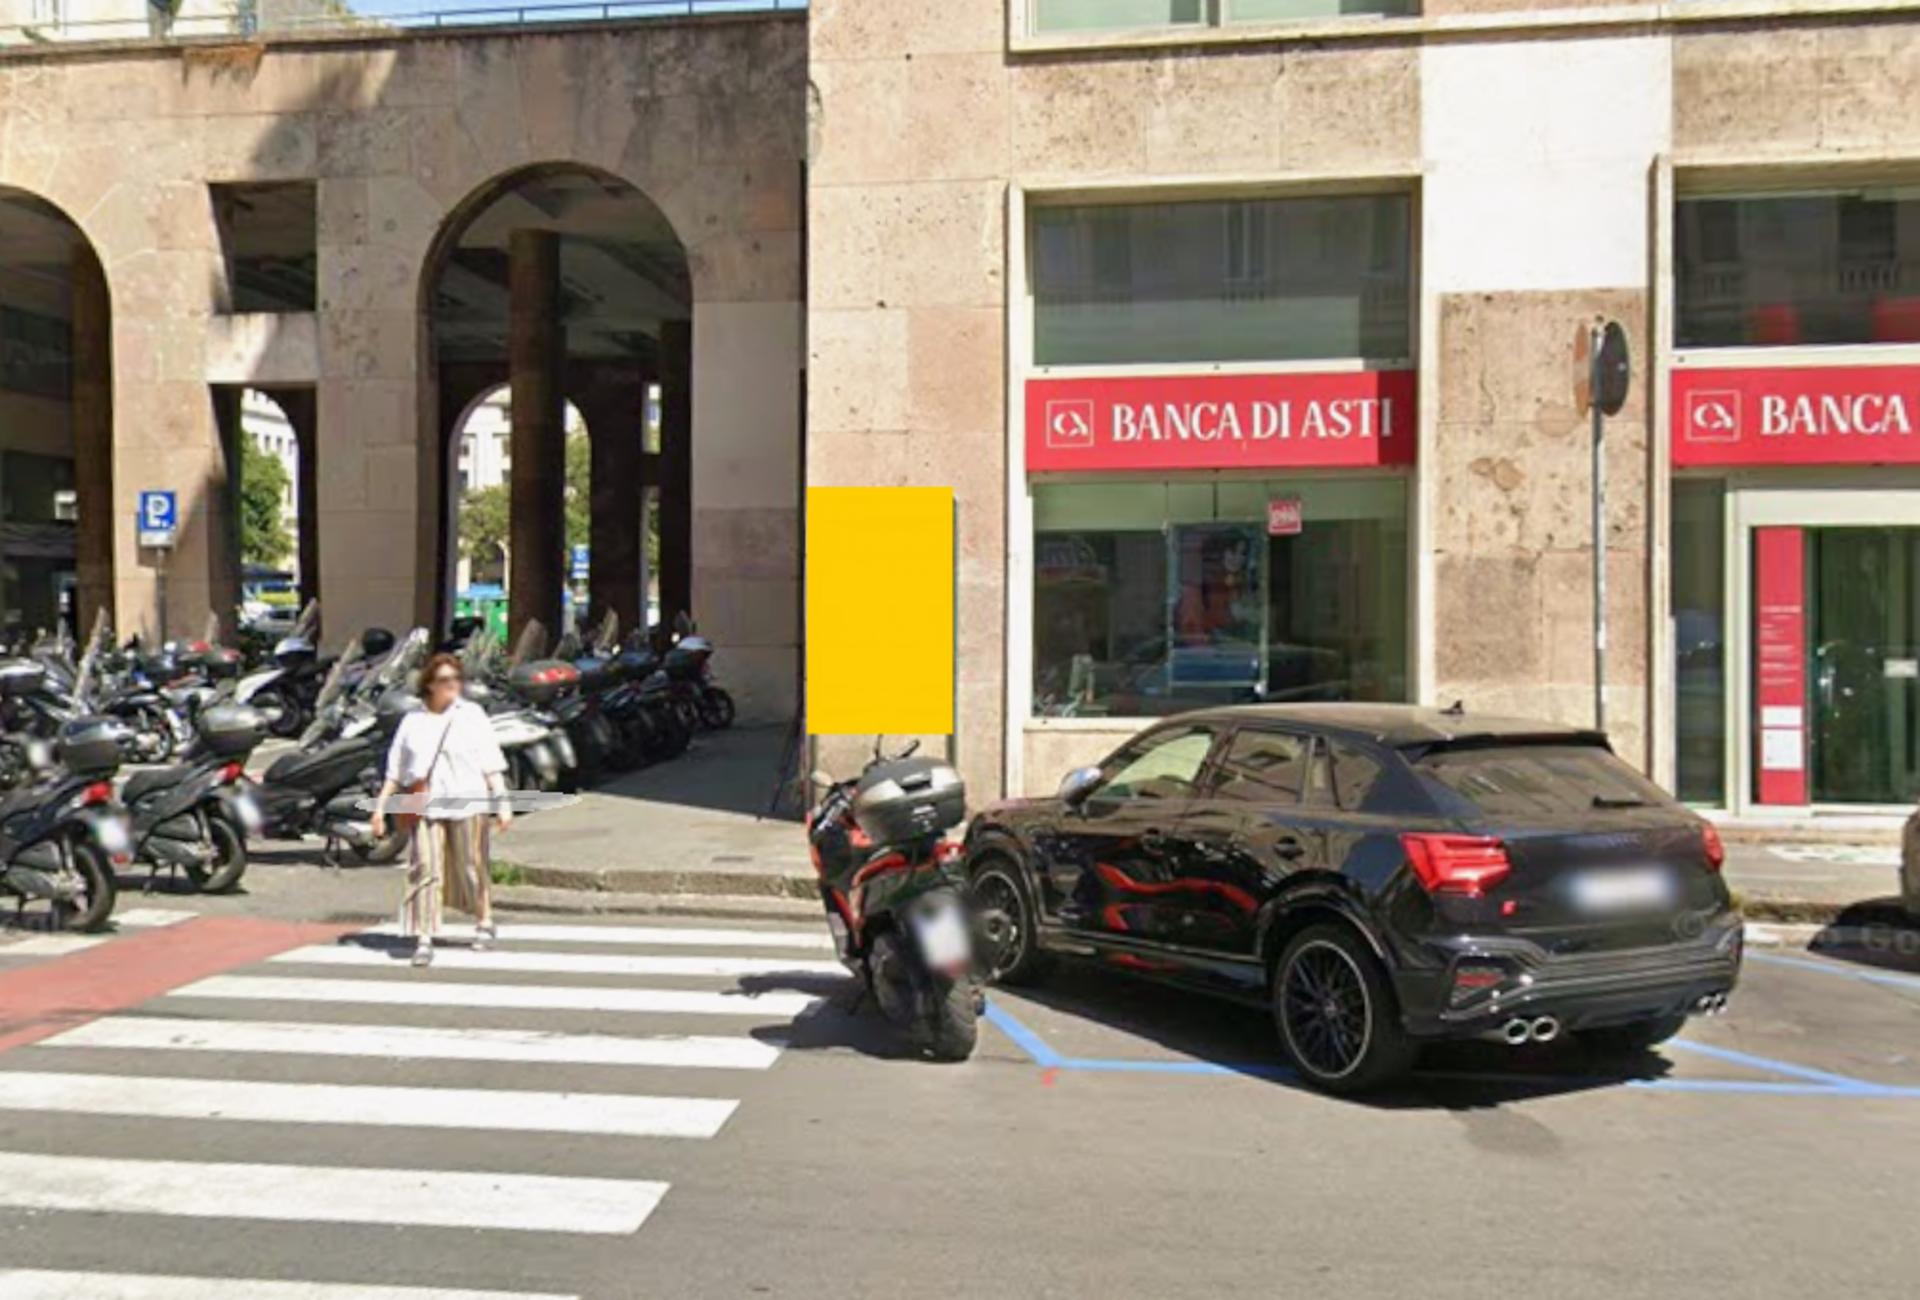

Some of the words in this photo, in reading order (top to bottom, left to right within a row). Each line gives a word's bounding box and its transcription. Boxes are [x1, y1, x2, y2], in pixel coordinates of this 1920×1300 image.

[1112, 402, 1244, 441] BANCA
[1252, 400, 1291, 439] DI
[1301, 398, 1393, 438] ASTI
[1759, 394, 1912, 436] BANCA
